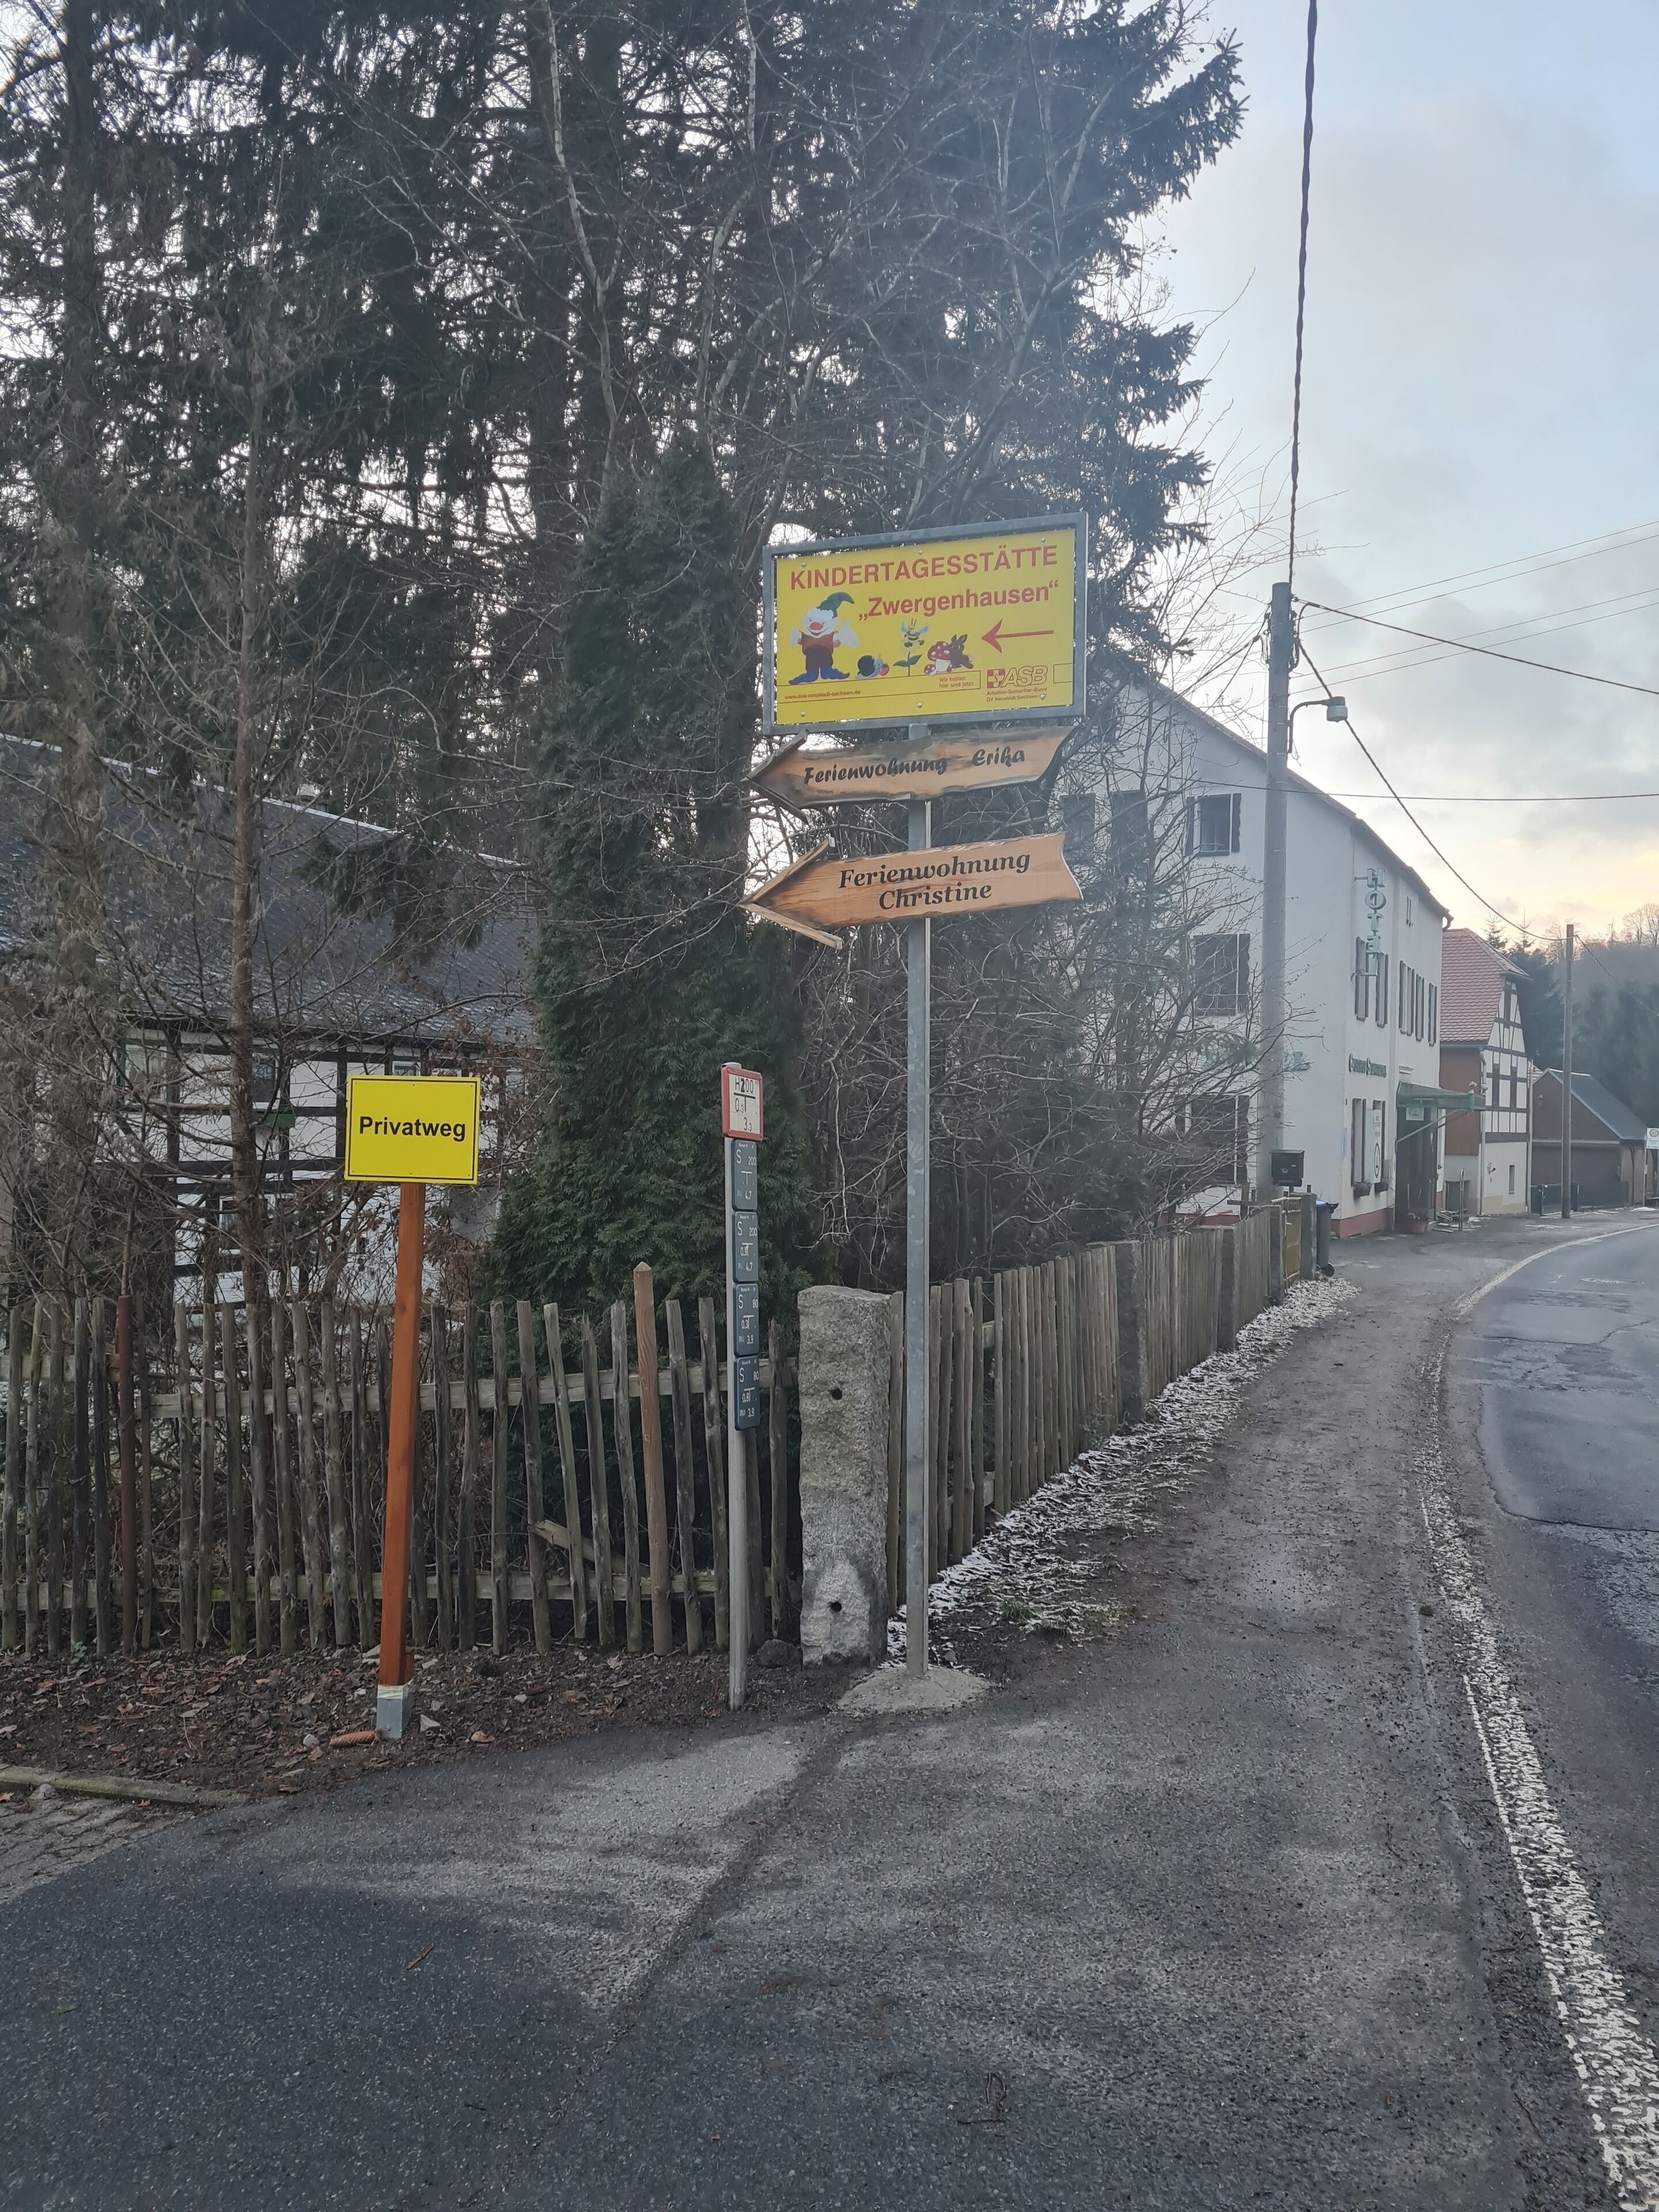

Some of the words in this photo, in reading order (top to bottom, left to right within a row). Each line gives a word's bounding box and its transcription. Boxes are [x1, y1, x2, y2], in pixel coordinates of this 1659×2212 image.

[790, 544, 1058, 590] KINDERTAGESSTÄTTE
[1000, 665, 1048, 688] ASB
[804, 757, 948, 784] Ferienwohnung
[972, 746, 1025, 767] Erika
[838, 853, 1031, 889] Ferienwohnung
[878, 881, 992, 910] Christine
[735, 1076, 754, 1093] H200
[359, 1116, 465, 1142] Privatweg
[736, 1149, 741, 1164] S
[748, 1156, 757, 1166] 200
[737, 1221, 743, 1236] S
[749, 1227, 757, 1236] 200
[738, 1294, 744, 1309] S
[739, 1367, 744, 1382] S
